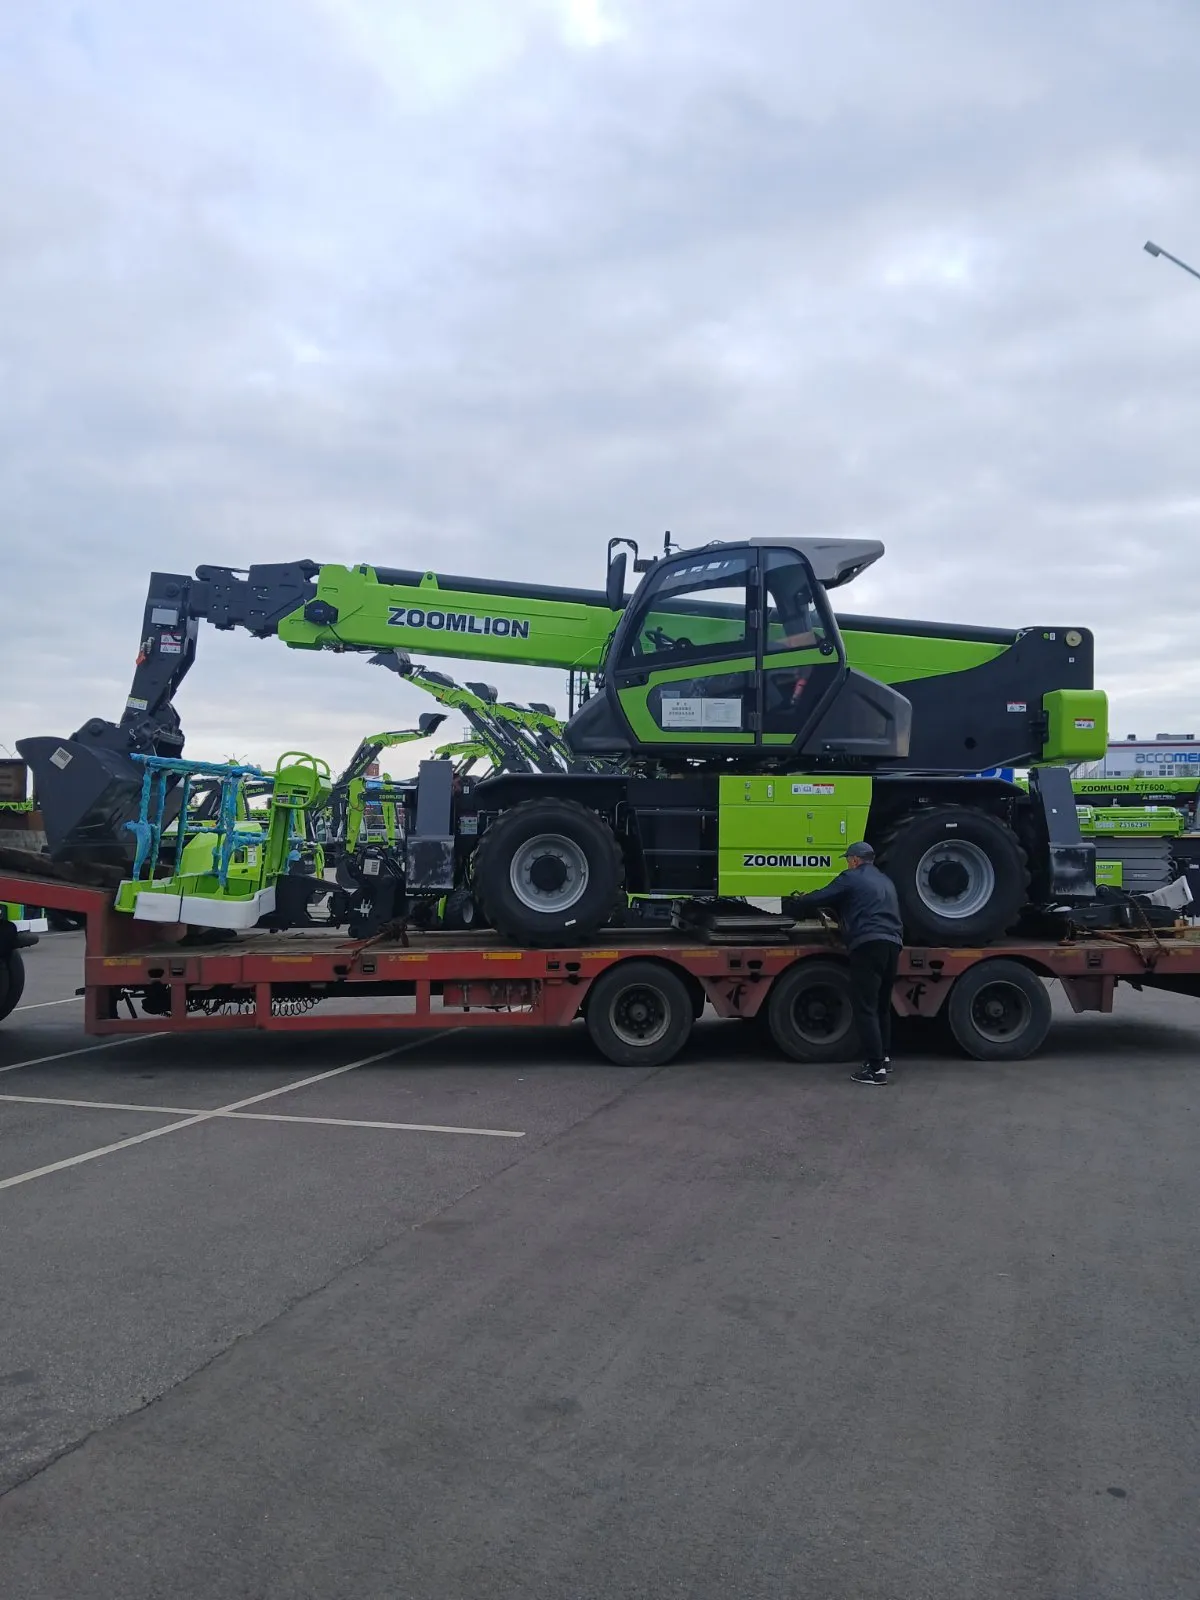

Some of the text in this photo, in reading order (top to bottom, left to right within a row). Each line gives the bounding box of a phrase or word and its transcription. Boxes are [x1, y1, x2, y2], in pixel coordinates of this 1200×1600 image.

[387, 607, 530, 638] ZOOMLION
[482, 730, 506, 757] ZOOMLION
[516, 738, 540, 761] ZOOMLION
[743, 855, 831, 867] ZOOMLION
